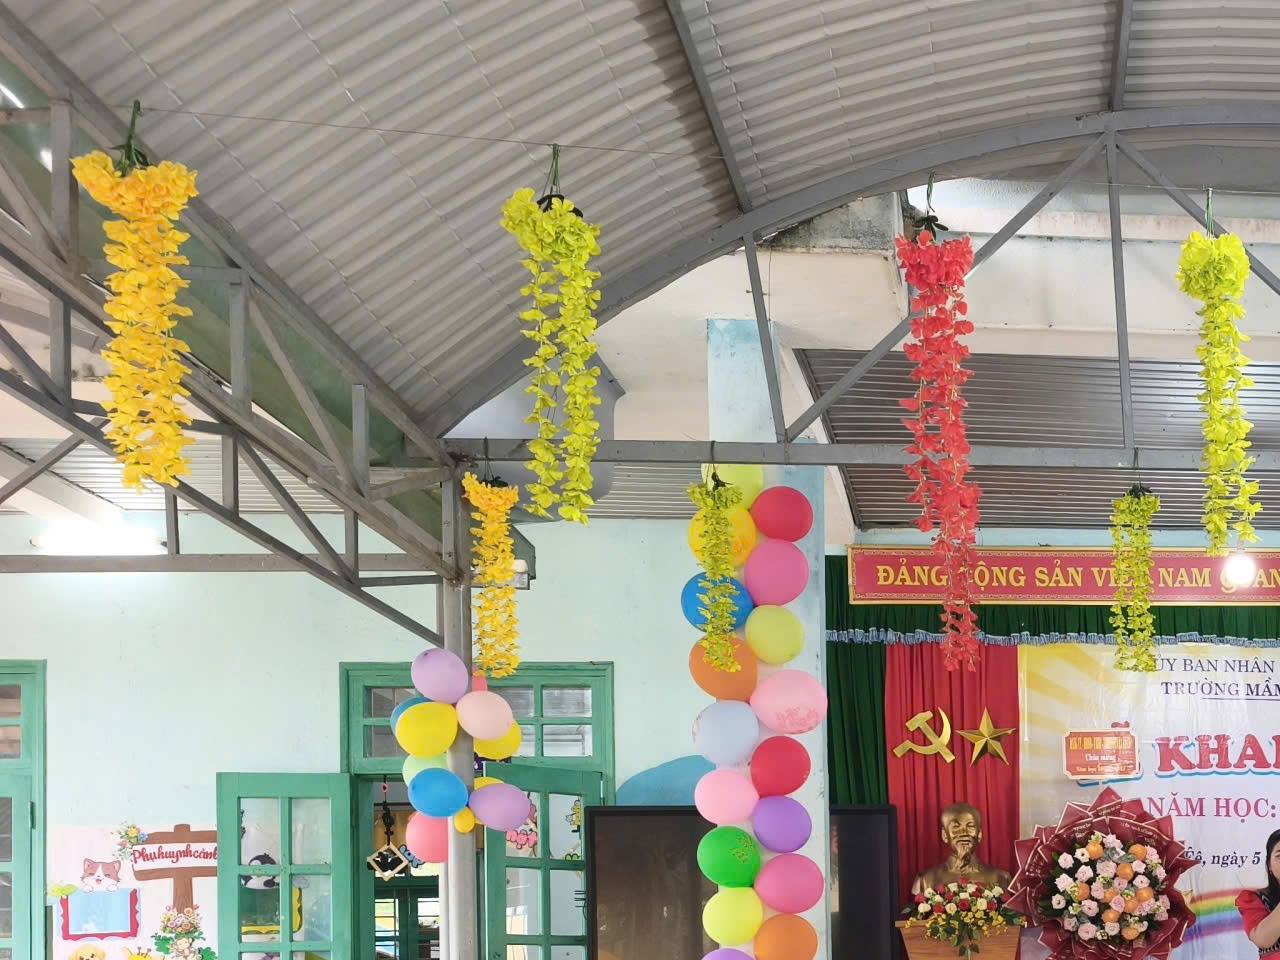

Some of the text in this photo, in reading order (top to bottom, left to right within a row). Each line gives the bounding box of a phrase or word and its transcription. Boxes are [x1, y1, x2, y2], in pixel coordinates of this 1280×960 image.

[877, 557, 948, 586] ĐẢNG
[1034, 559, 1083, 587] SẢN
[1158, 567, 1211, 589] NAM
[1182, 658, 1219, 672] BAN
[1224, 658, 1275, 674] NHÂN
[1161, 677, 1240, 697] TRƯỜNG
[1148, 791, 1206, 817] NĂM
[1214, 797, 1277, 823] HỌC:
[1210, 851, 1248, 868] ngày
[1252, 852, 1261, 866] 5
